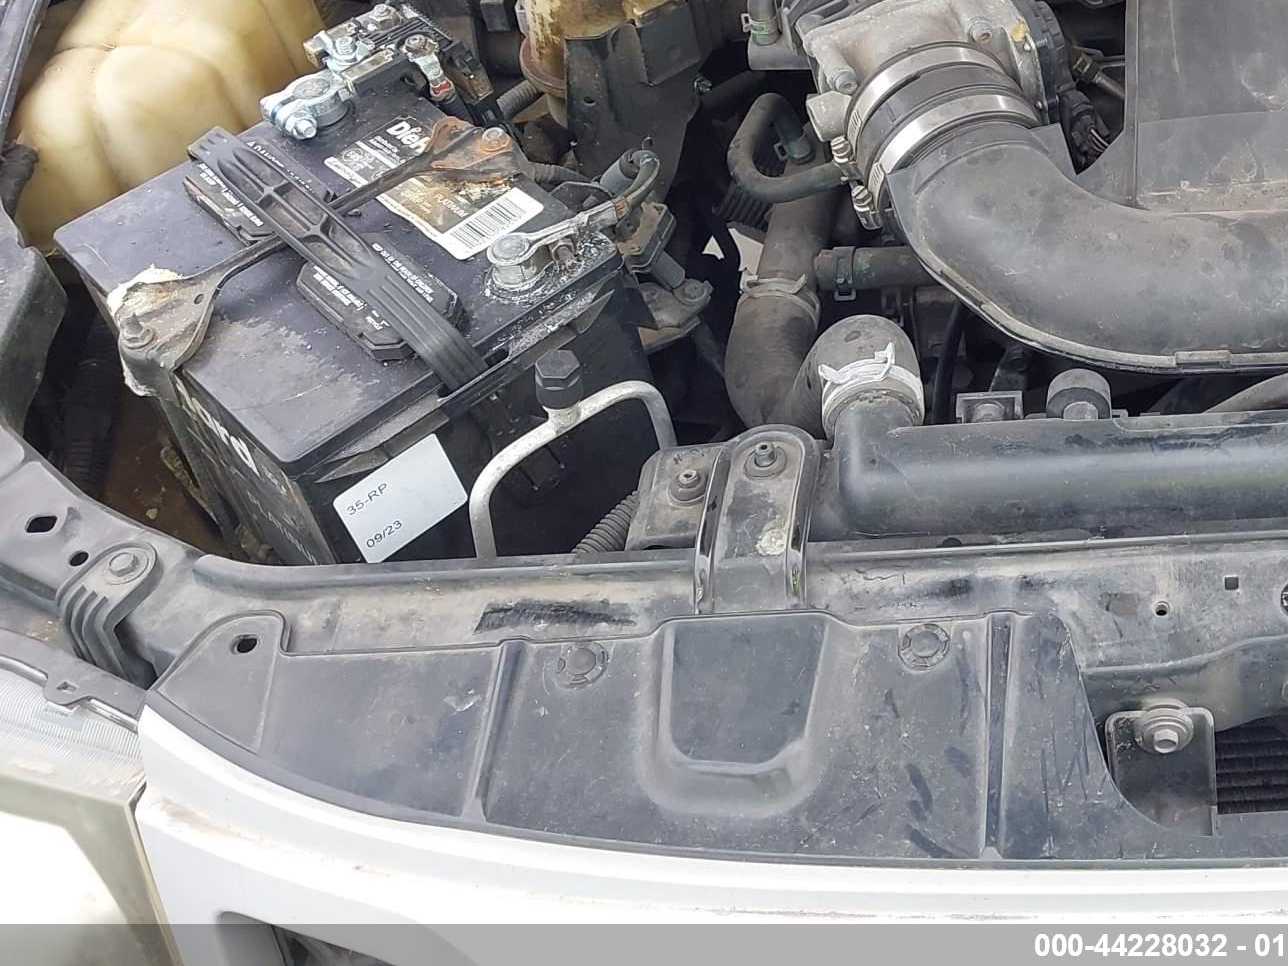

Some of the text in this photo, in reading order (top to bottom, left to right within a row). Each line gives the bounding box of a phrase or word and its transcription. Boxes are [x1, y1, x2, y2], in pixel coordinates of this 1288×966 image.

[386, 120, 430, 154] DieH
[346, 482, 388, 516] 35-RP
[366, 520, 403, 548] 09/23
